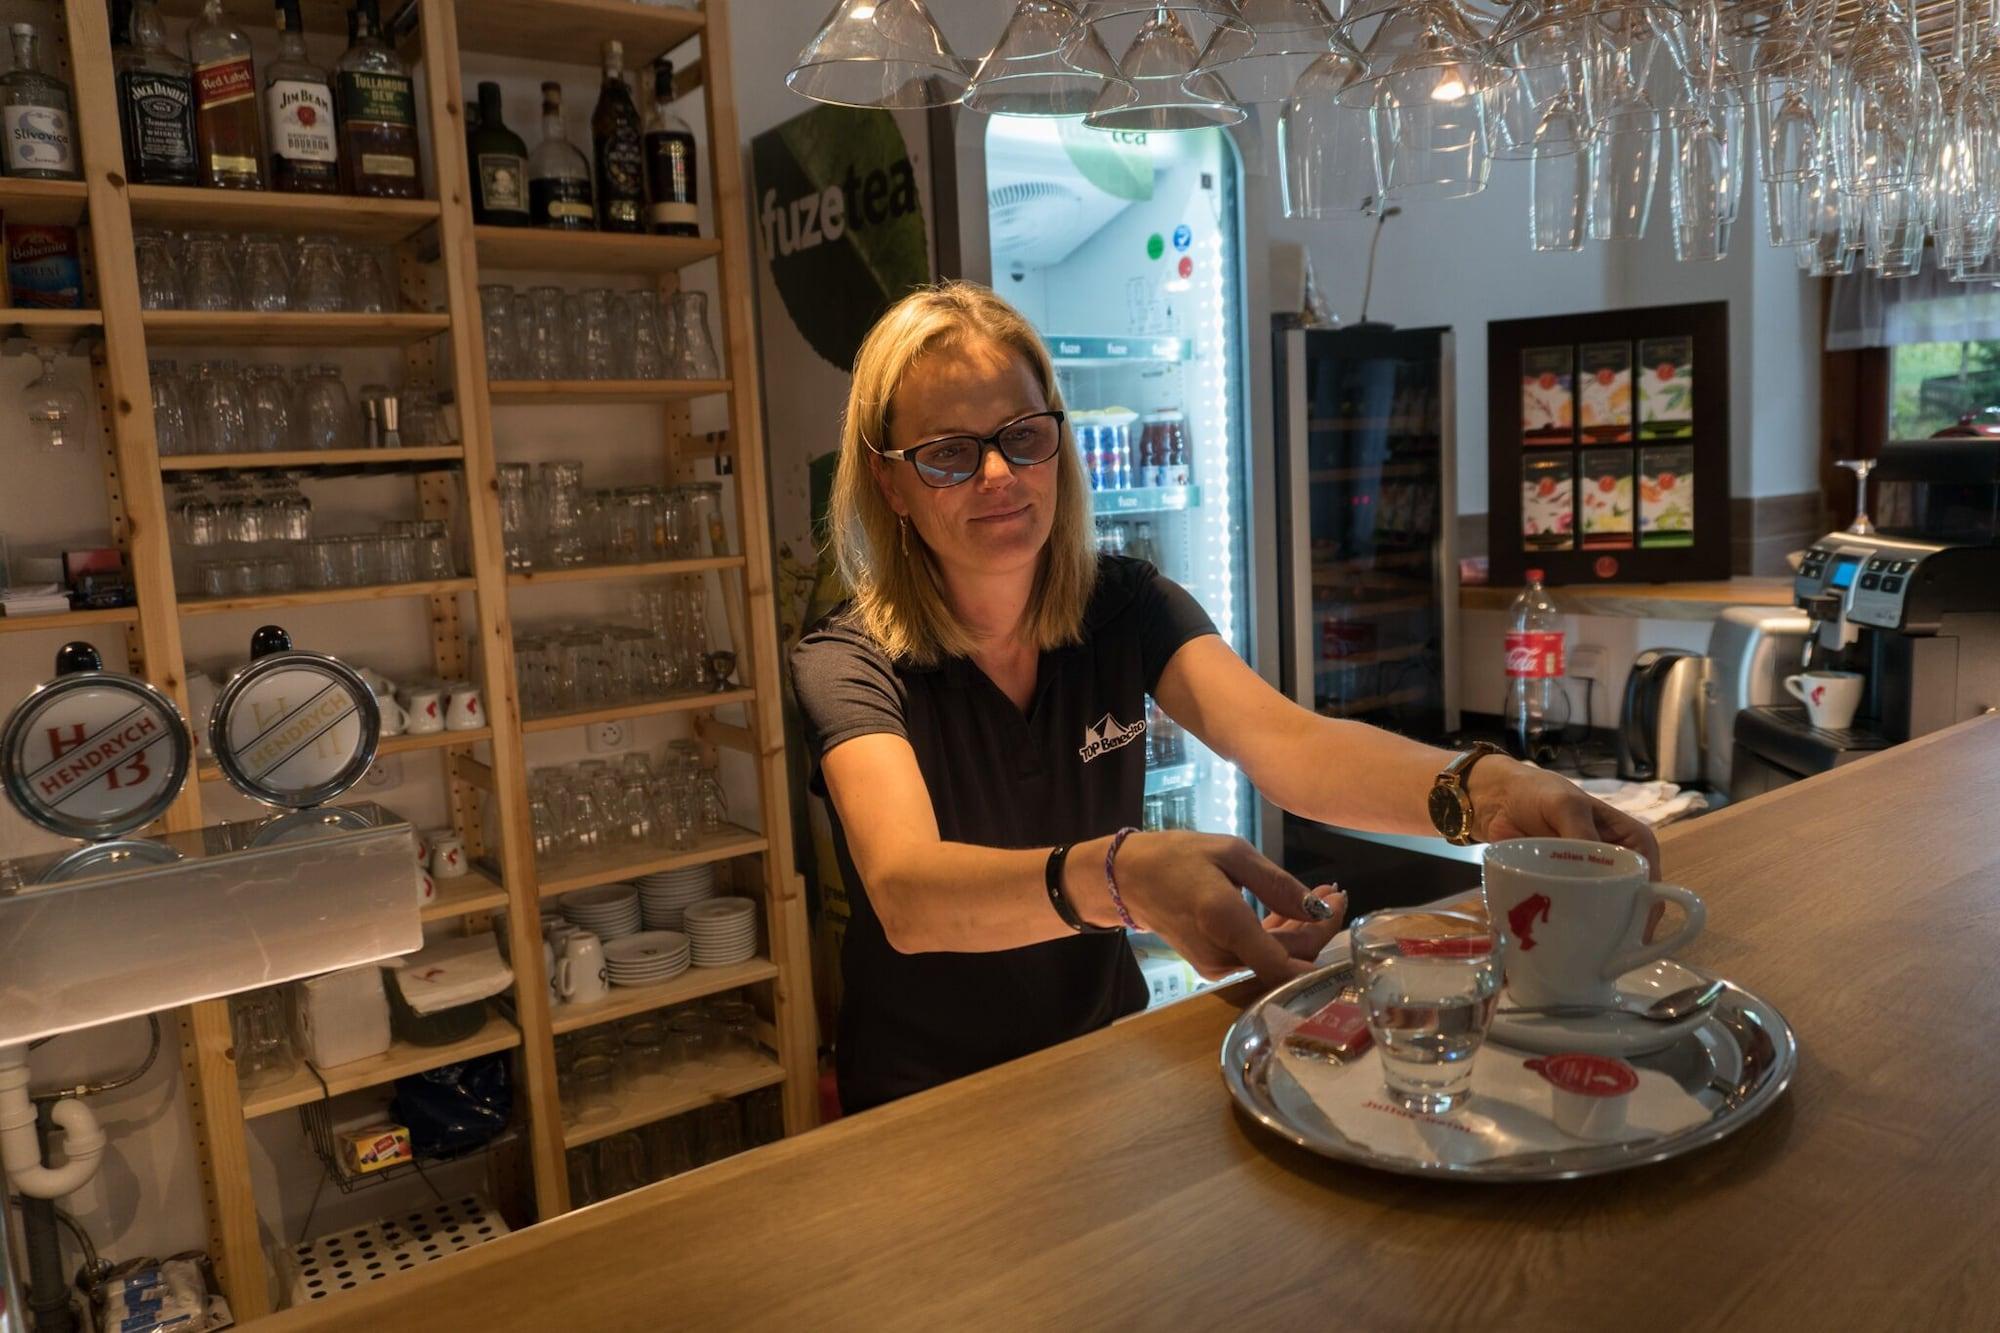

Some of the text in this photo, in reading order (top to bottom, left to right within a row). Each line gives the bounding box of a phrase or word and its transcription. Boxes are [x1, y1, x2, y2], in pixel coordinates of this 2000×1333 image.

[201, 75, 223, 91] Red
[223, 69, 250, 84] Label
[131, 84, 155, 101] JACK
[280, 89, 329, 113] JIM BEAM
[250, 693, 349, 769] HENDRYCH
[40, 717, 157, 795] HENDRYCH
